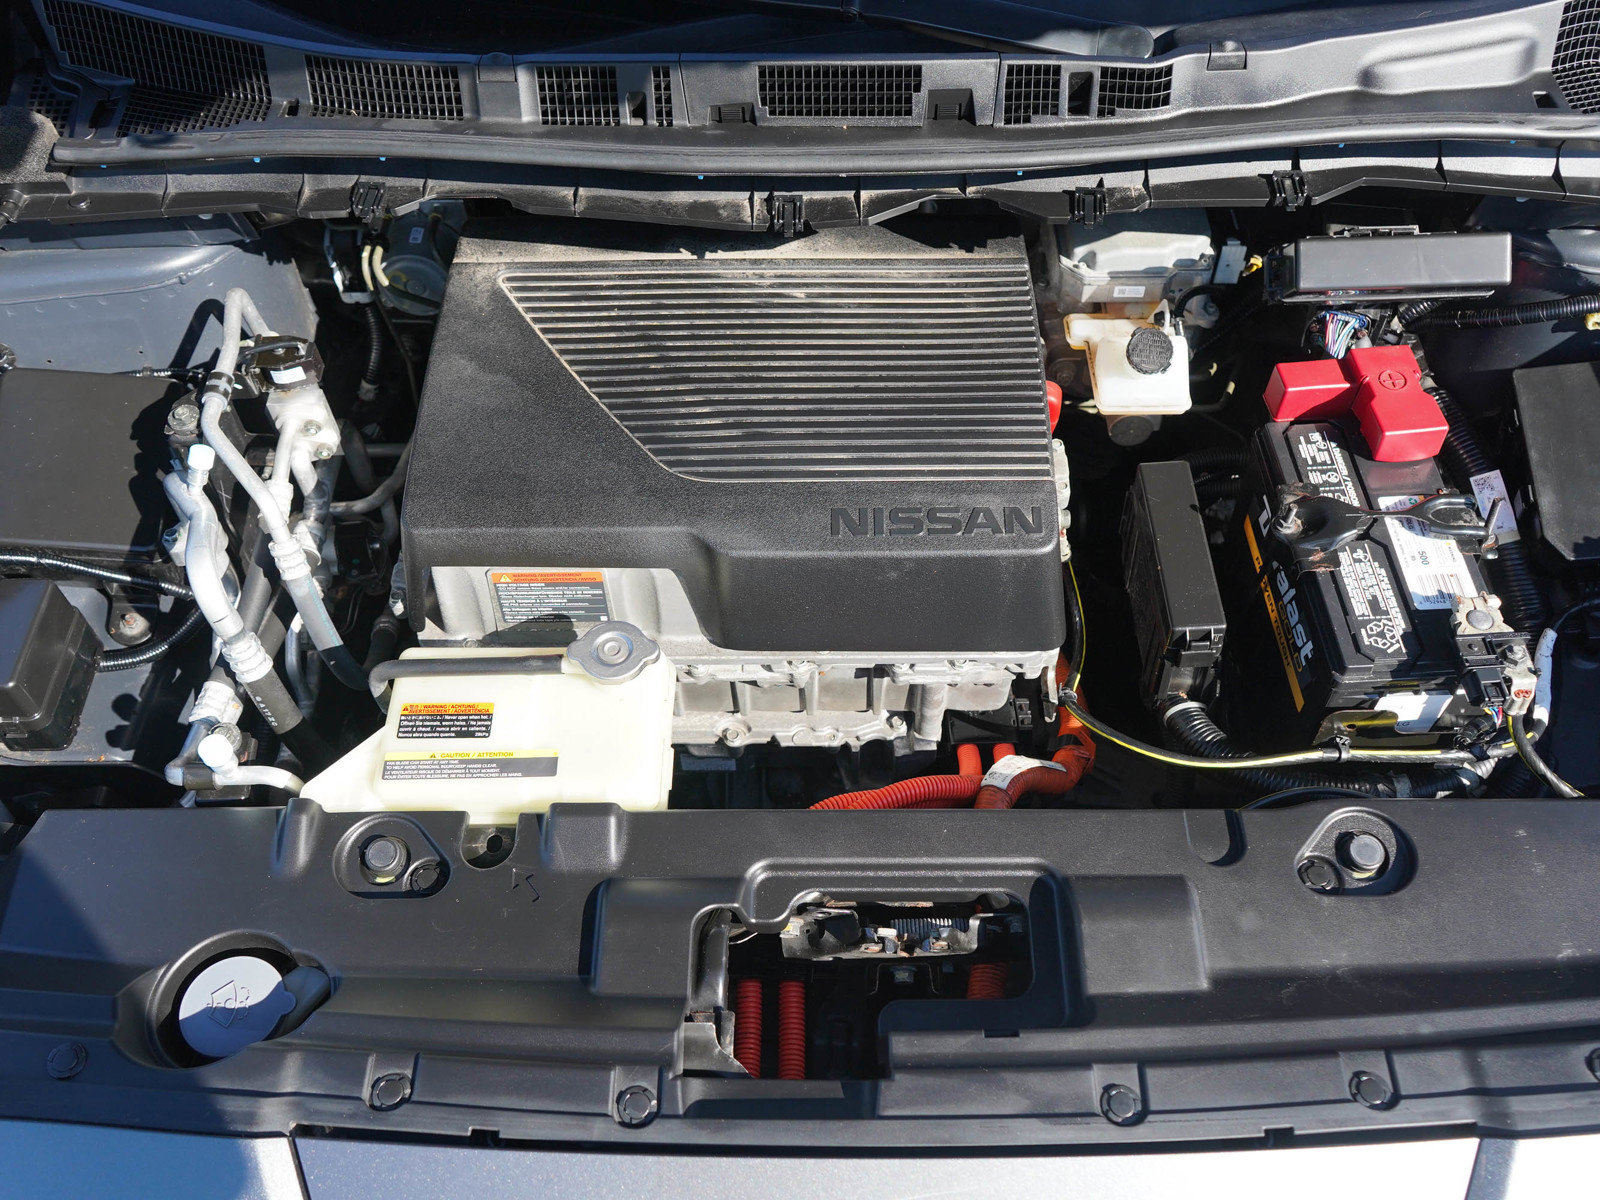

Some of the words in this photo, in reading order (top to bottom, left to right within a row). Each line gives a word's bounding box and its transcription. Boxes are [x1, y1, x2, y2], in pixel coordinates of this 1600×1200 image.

[1333, 448, 1348, 474] DANGER
[830, 506, 1044, 536] NISSAN
[1418, 550, 1430, 566] 500
[1278, 601, 1303, 673] GOLD
